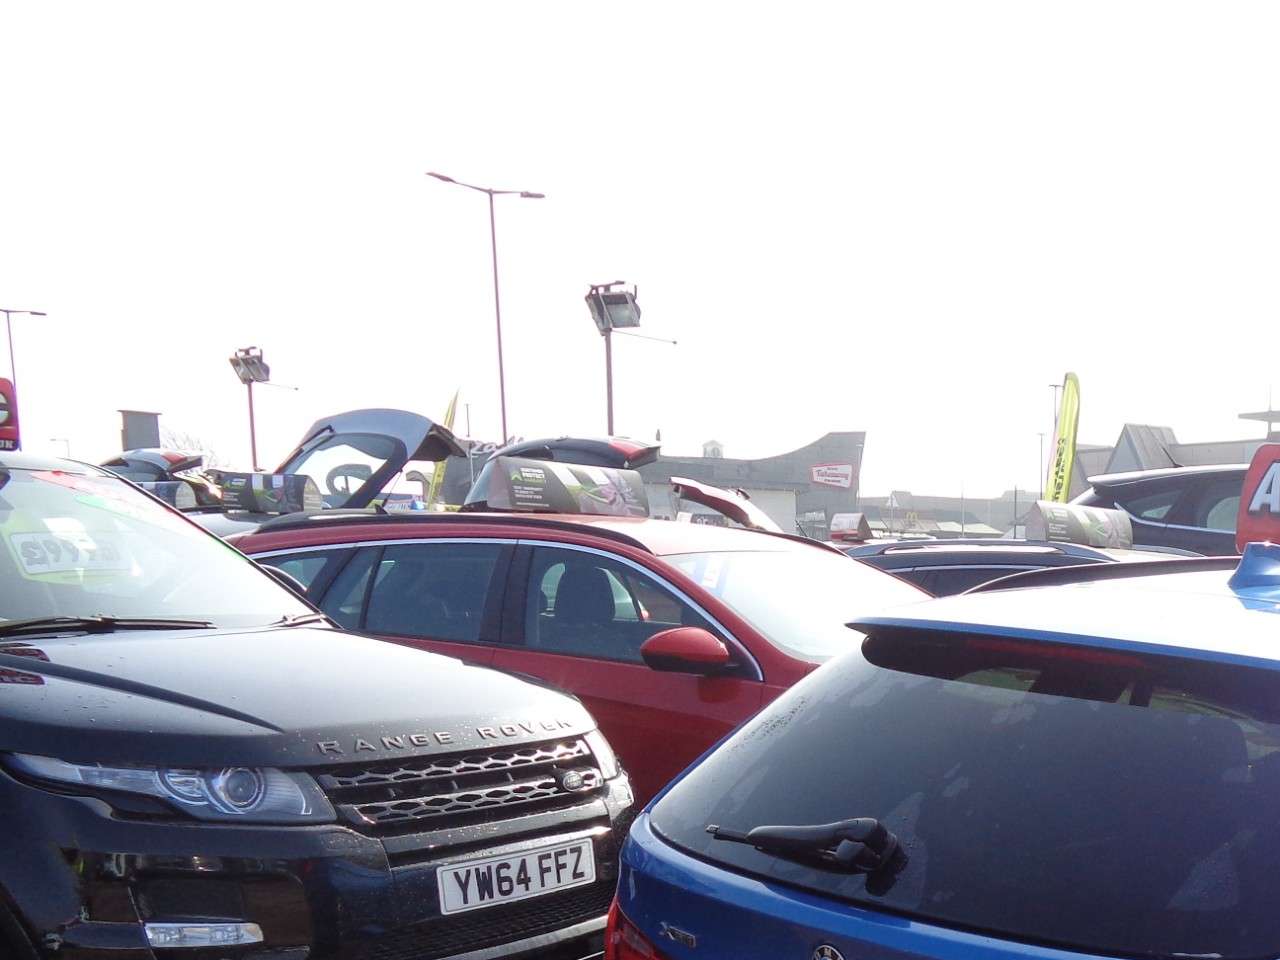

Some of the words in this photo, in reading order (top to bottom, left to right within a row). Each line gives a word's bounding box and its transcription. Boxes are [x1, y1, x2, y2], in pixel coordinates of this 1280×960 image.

[317, 731, 454, 755] RANGE
[476, 719, 572, 740] ROVER
[453, 858, 532, 905] YW64
[537, 846, 585, 888] FFZ
